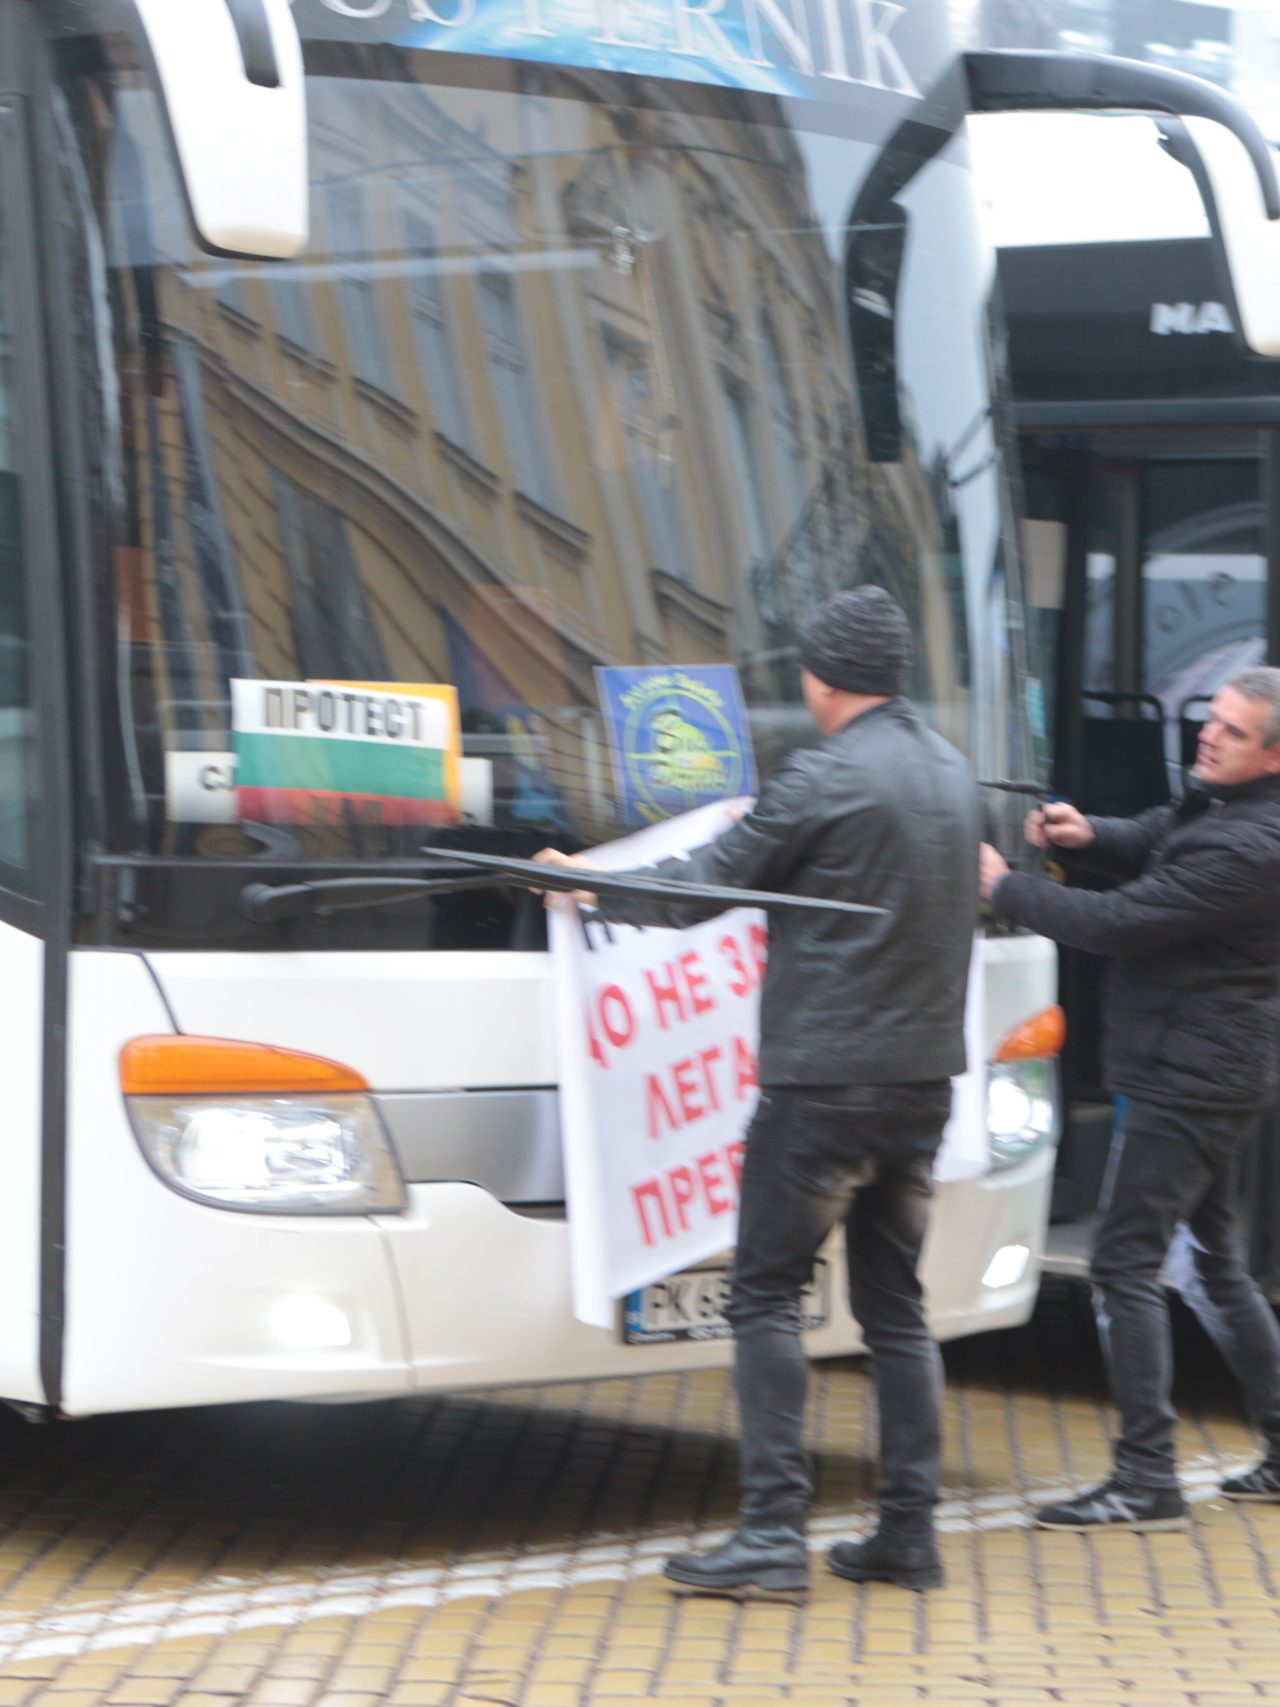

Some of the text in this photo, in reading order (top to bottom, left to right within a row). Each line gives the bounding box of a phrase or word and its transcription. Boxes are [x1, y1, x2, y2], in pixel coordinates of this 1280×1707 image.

[1150, 301, 1235, 335] MA
[263, 686, 426, 741] ПРОТЕСТ
[642, 952, 715, 1029] НЕ
[645, 1036, 761, 1140] ЛЕГА
